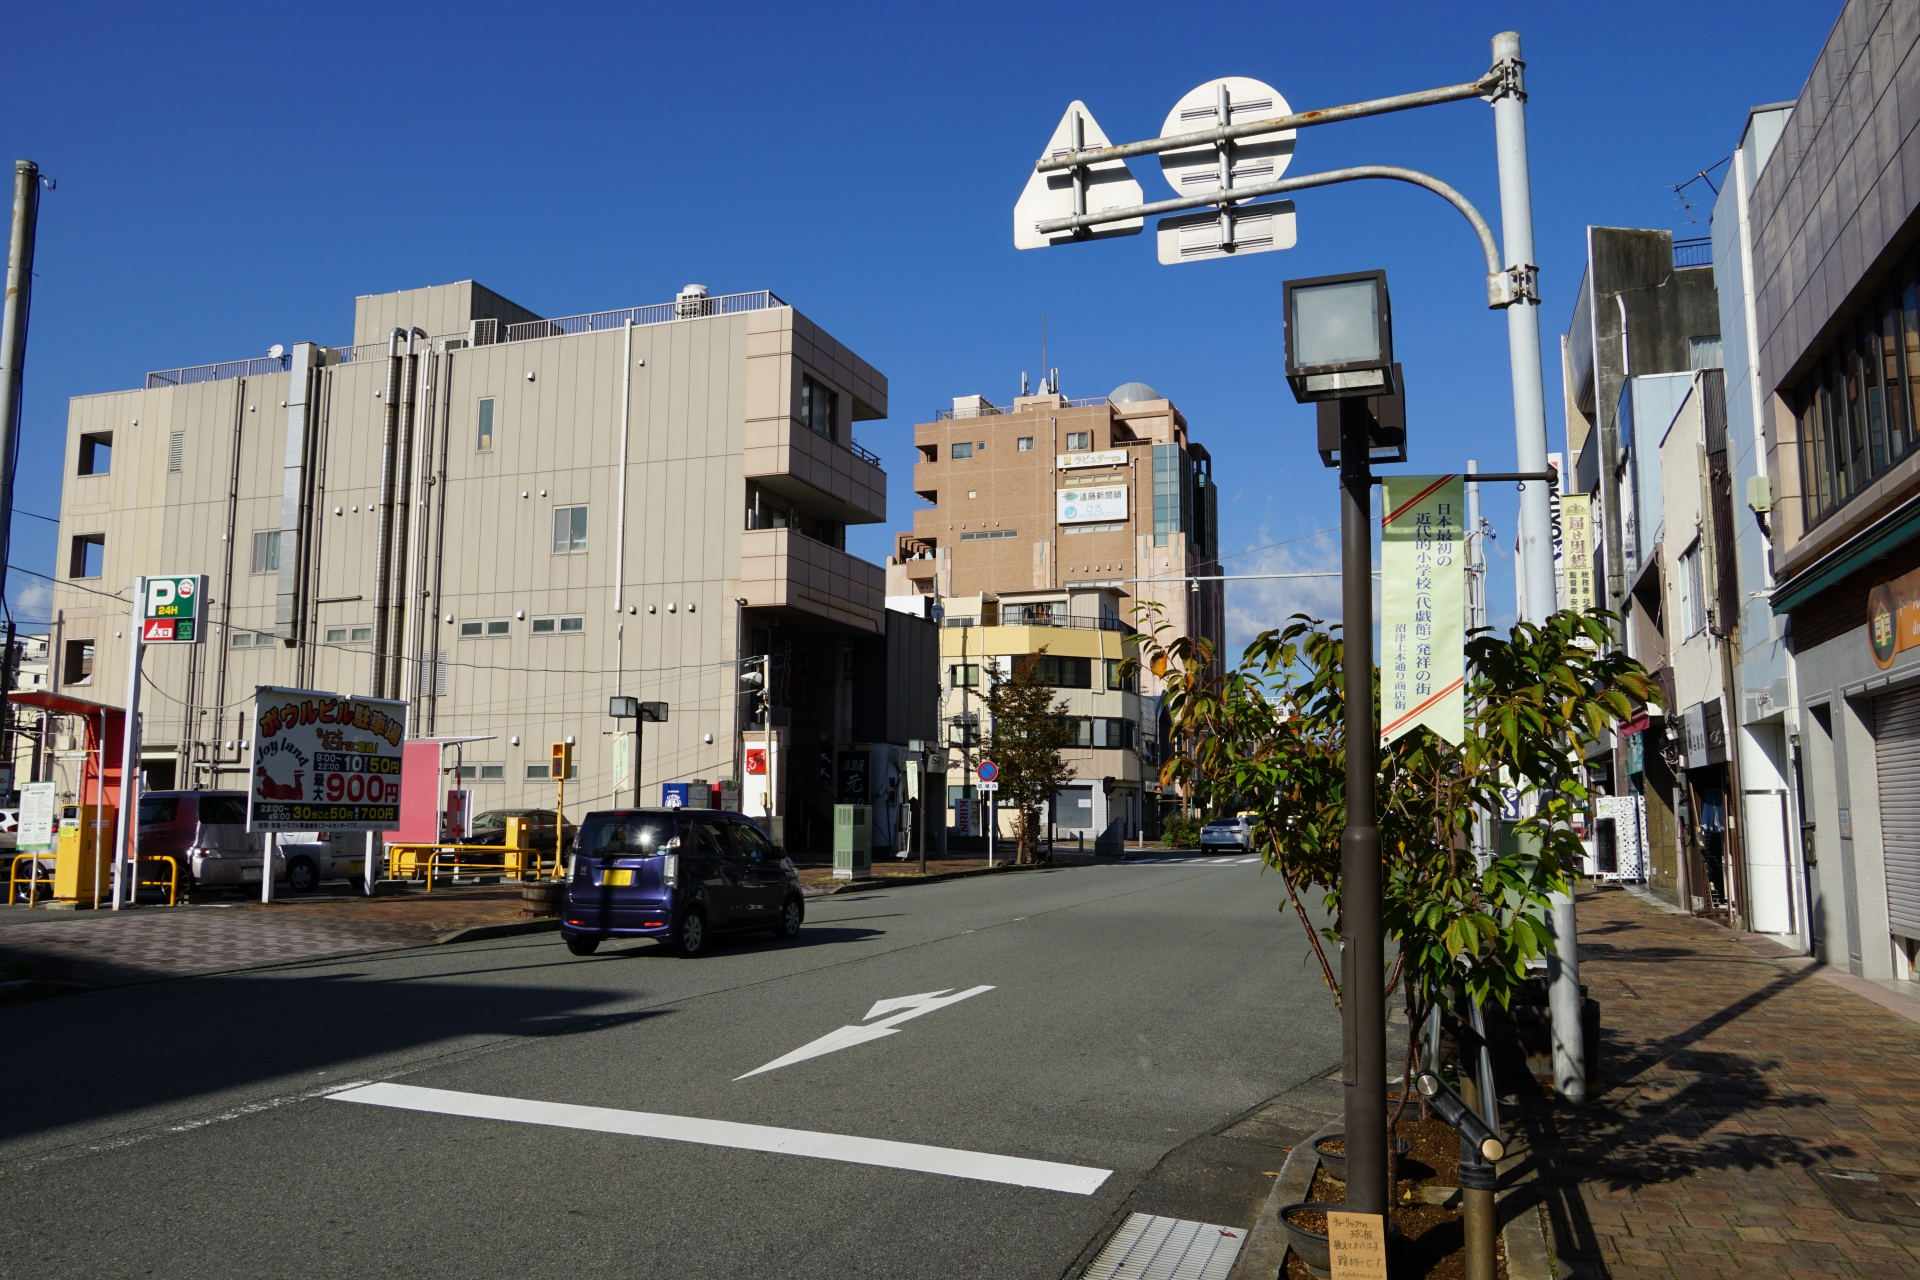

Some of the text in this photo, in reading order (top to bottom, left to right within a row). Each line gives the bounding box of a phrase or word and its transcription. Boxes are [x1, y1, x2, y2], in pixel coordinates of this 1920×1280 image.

[1086, 504, 1102, 513] ひろ
[1436, 503, 1452, 566] 日本最初の
[1569, 517, 1587, 568] 届け用紙
[147, 580, 176, 616] P
[158, 605, 178, 615] 24H
[177, 620, 193, 639] 空
[1394, 624, 1406, 710] 沼津上本通り商店街
[259, 698, 403, 747] ボウルビル駐車場
[316, 727, 343, 740] ちょっと
[256, 737, 310, 767] Joy land
[344, 756, 362, 771] 10
[369, 757, 399, 774] 50円
[317, 763, 340, 771] 22:00
[313, 773, 324, 801] 最大
[326, 773, 399, 803] 900円
[845, 774, 863, 792] 元
[361, 808, 394, 820] 700円
[960, 801, 968, 832] KIRIN
